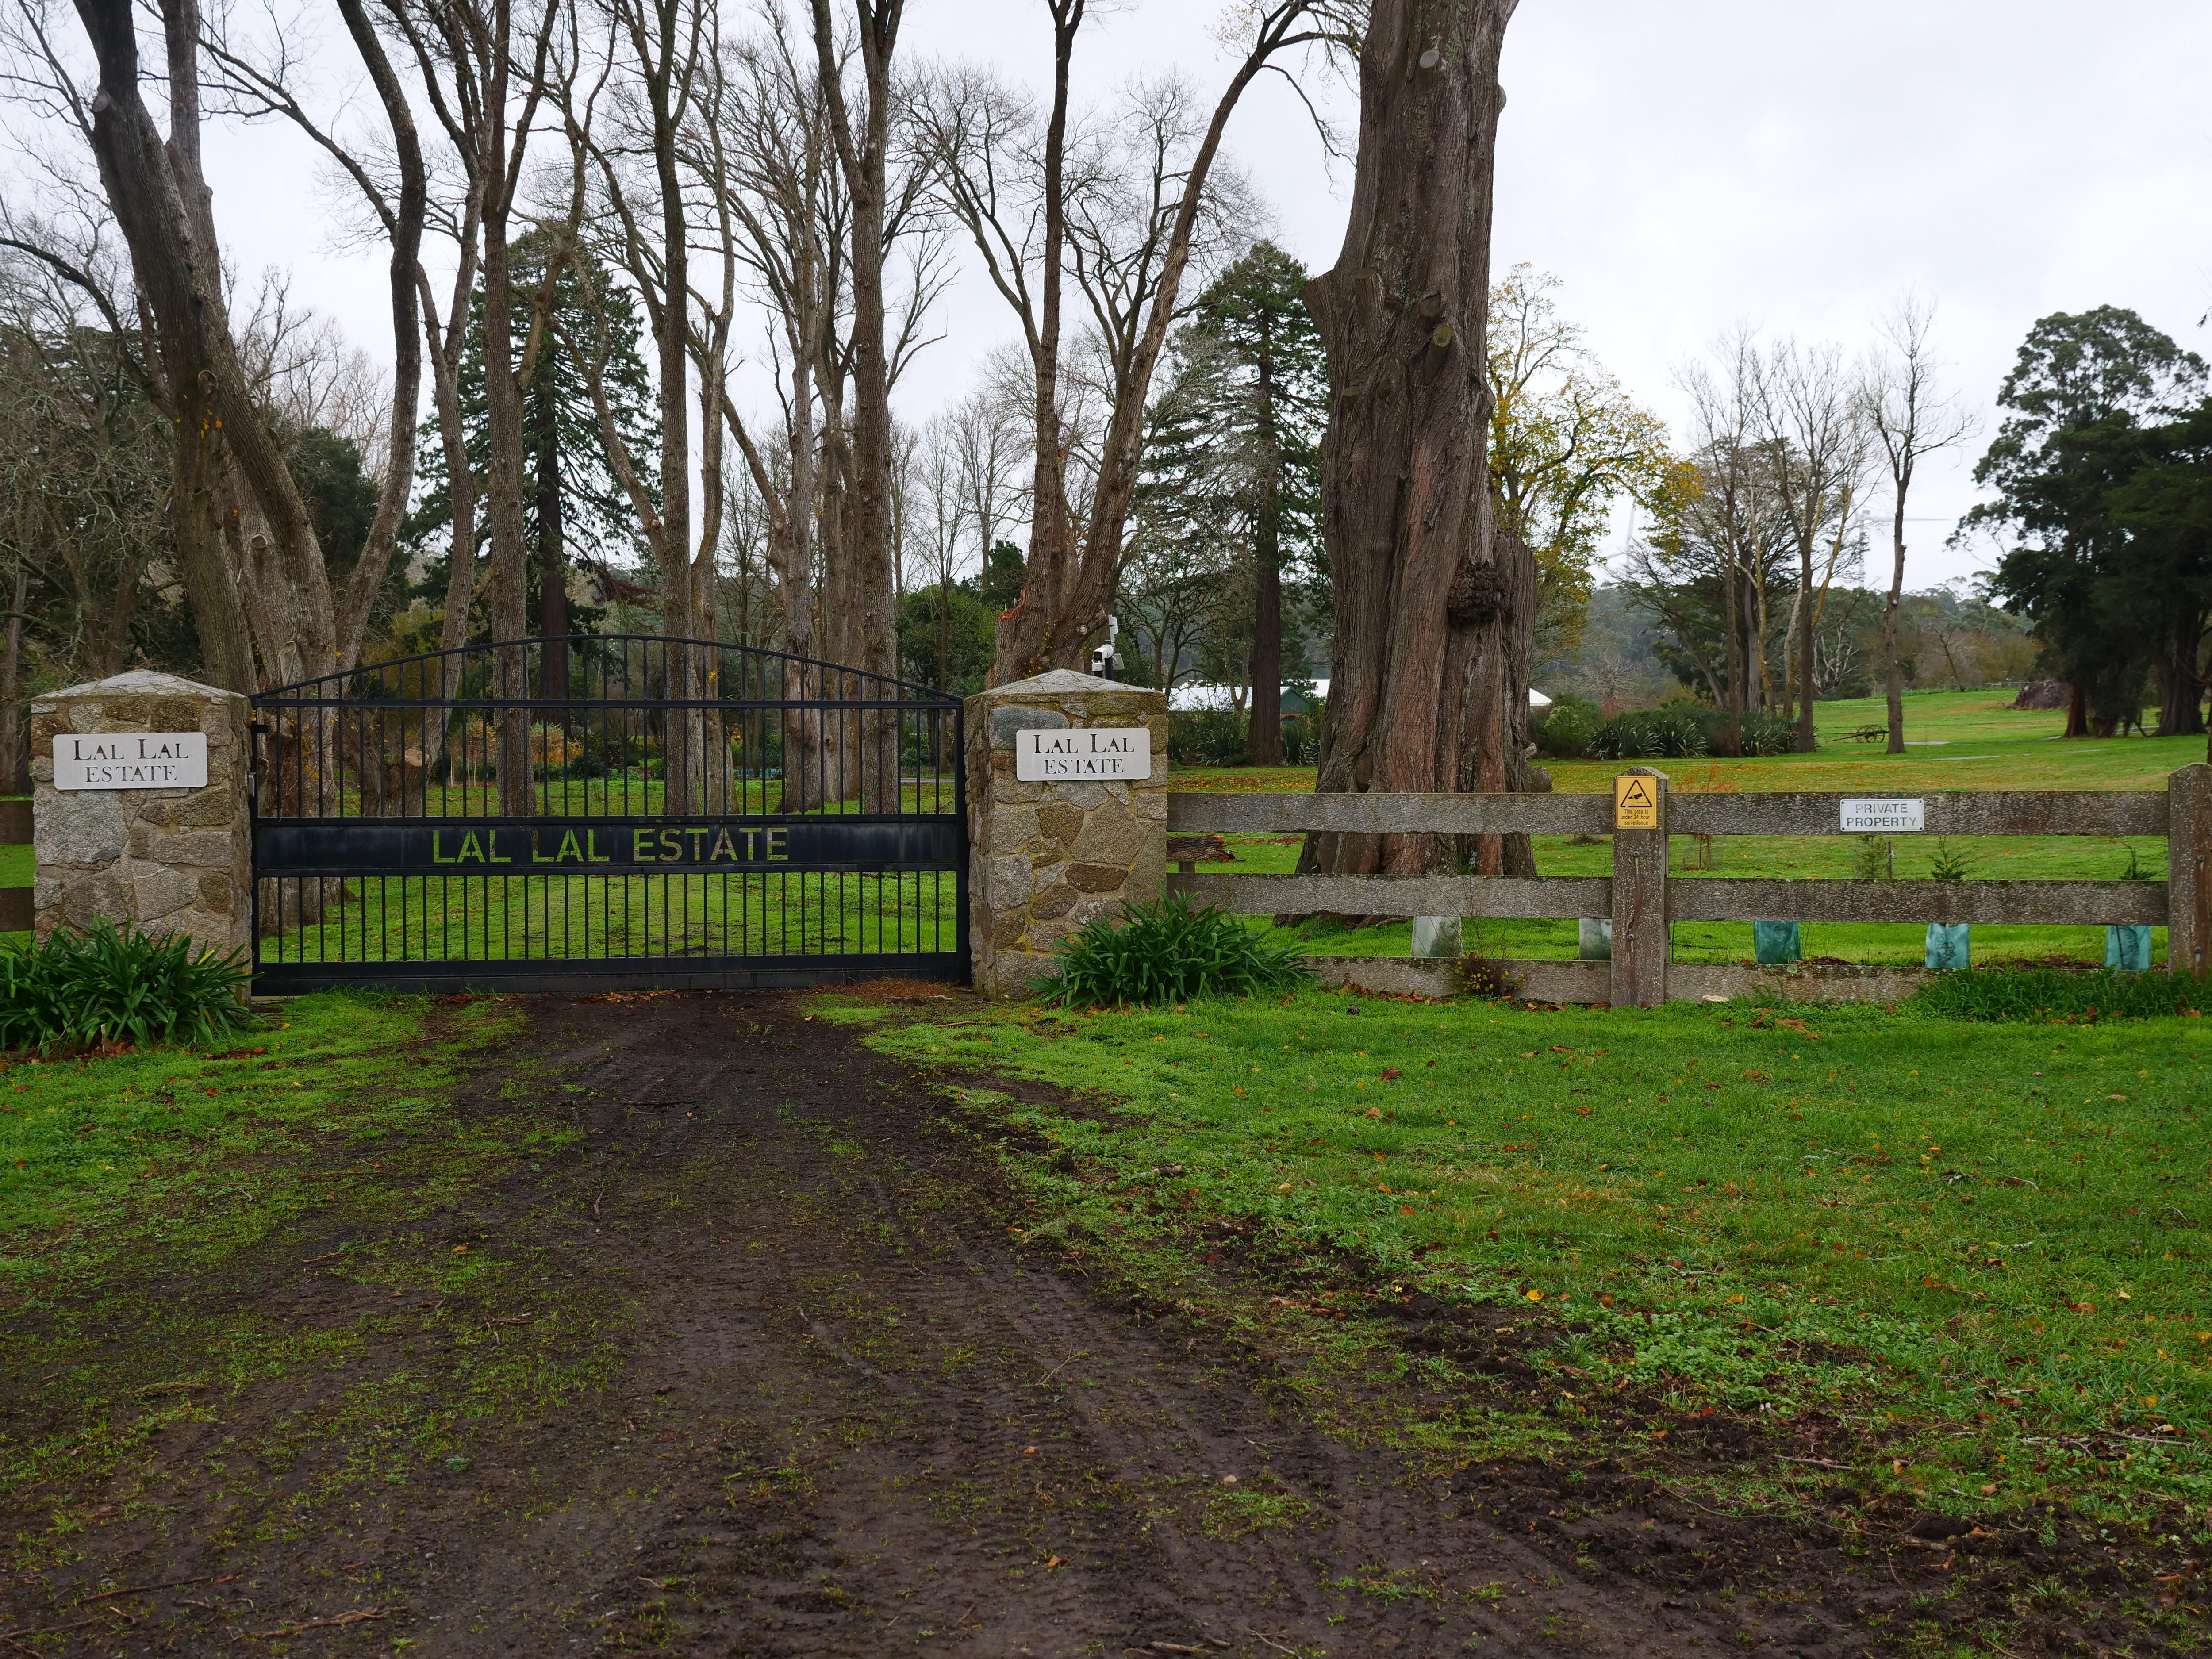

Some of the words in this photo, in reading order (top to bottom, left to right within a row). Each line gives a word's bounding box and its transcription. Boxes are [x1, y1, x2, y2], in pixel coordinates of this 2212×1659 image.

[85, 765, 177, 782] ESTATE
[1044, 758, 1124, 774] ESTATE
[1855, 803, 1908, 813] PRIVATE
[1847, 817, 1916, 826] PROPERTY
[433, 830, 511, 863] LAL
[533, 829, 610, 862] LAL
[634, 828, 789, 861] ESTATE
